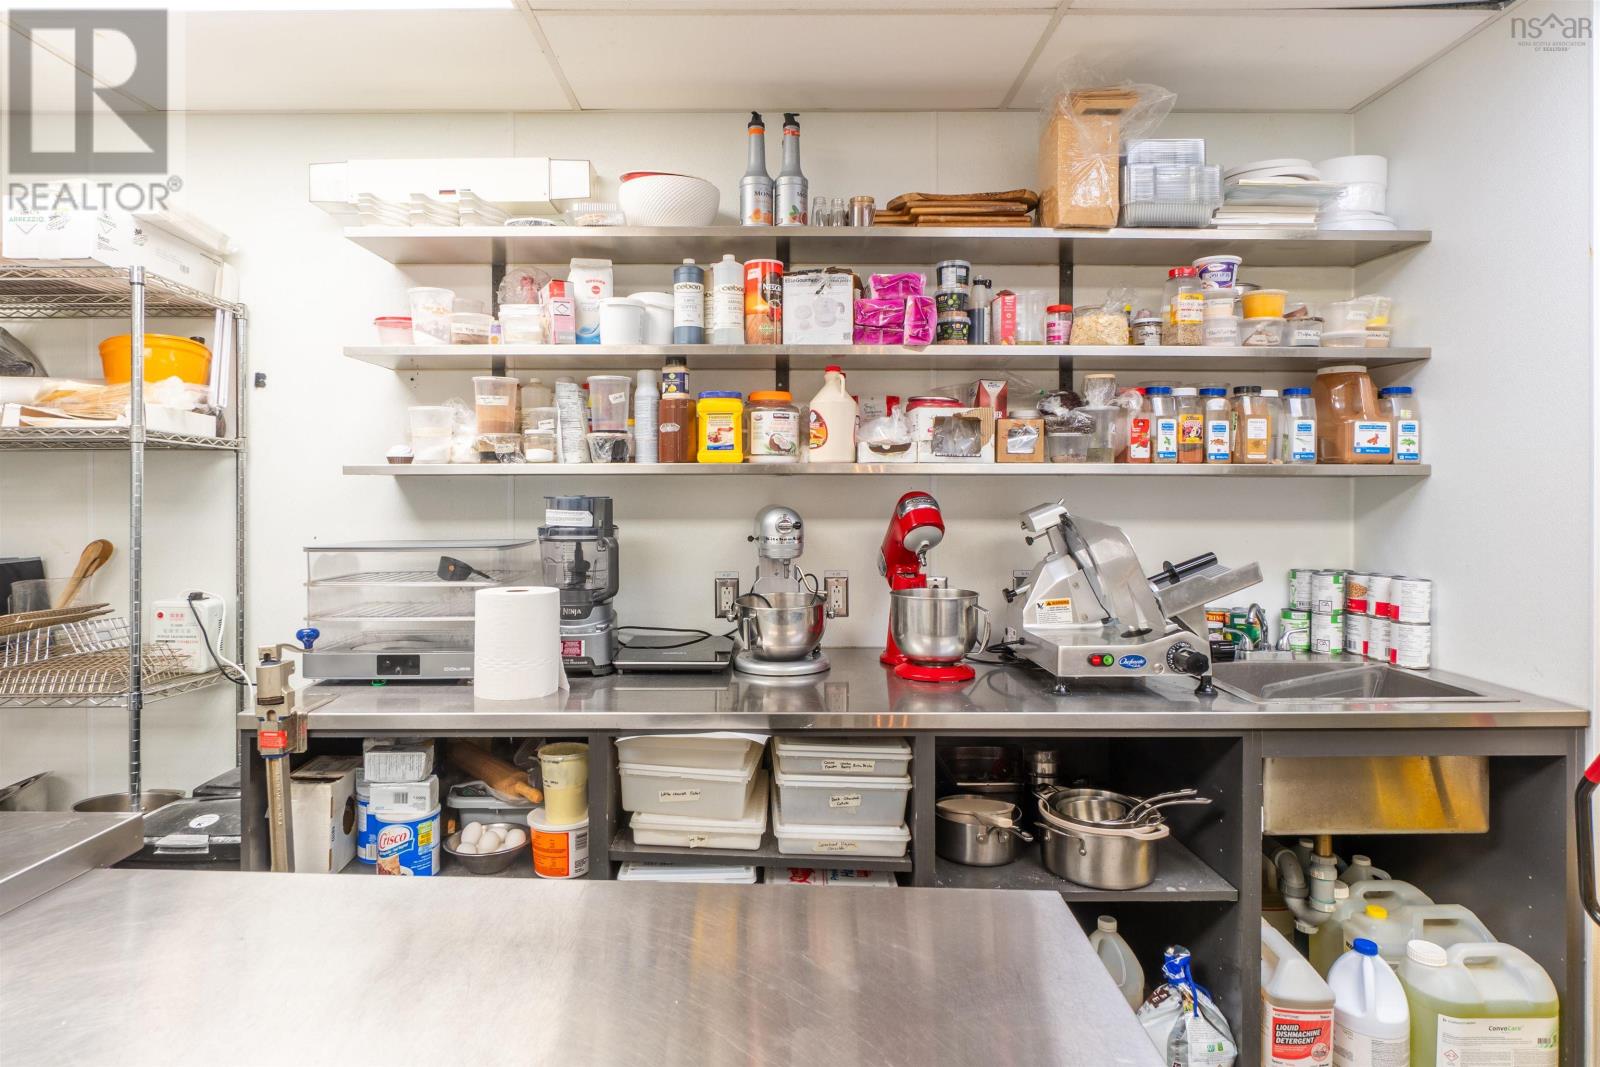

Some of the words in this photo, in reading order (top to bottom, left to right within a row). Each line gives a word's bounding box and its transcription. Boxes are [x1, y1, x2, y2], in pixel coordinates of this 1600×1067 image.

[562, 607, 582, 617] NINJA
[379, 832, 408, 849] Crisco
[1275, 1029, 1321, 1038] DISHMACHINE
[1275, 1037, 1315, 1045] DETERGENT
